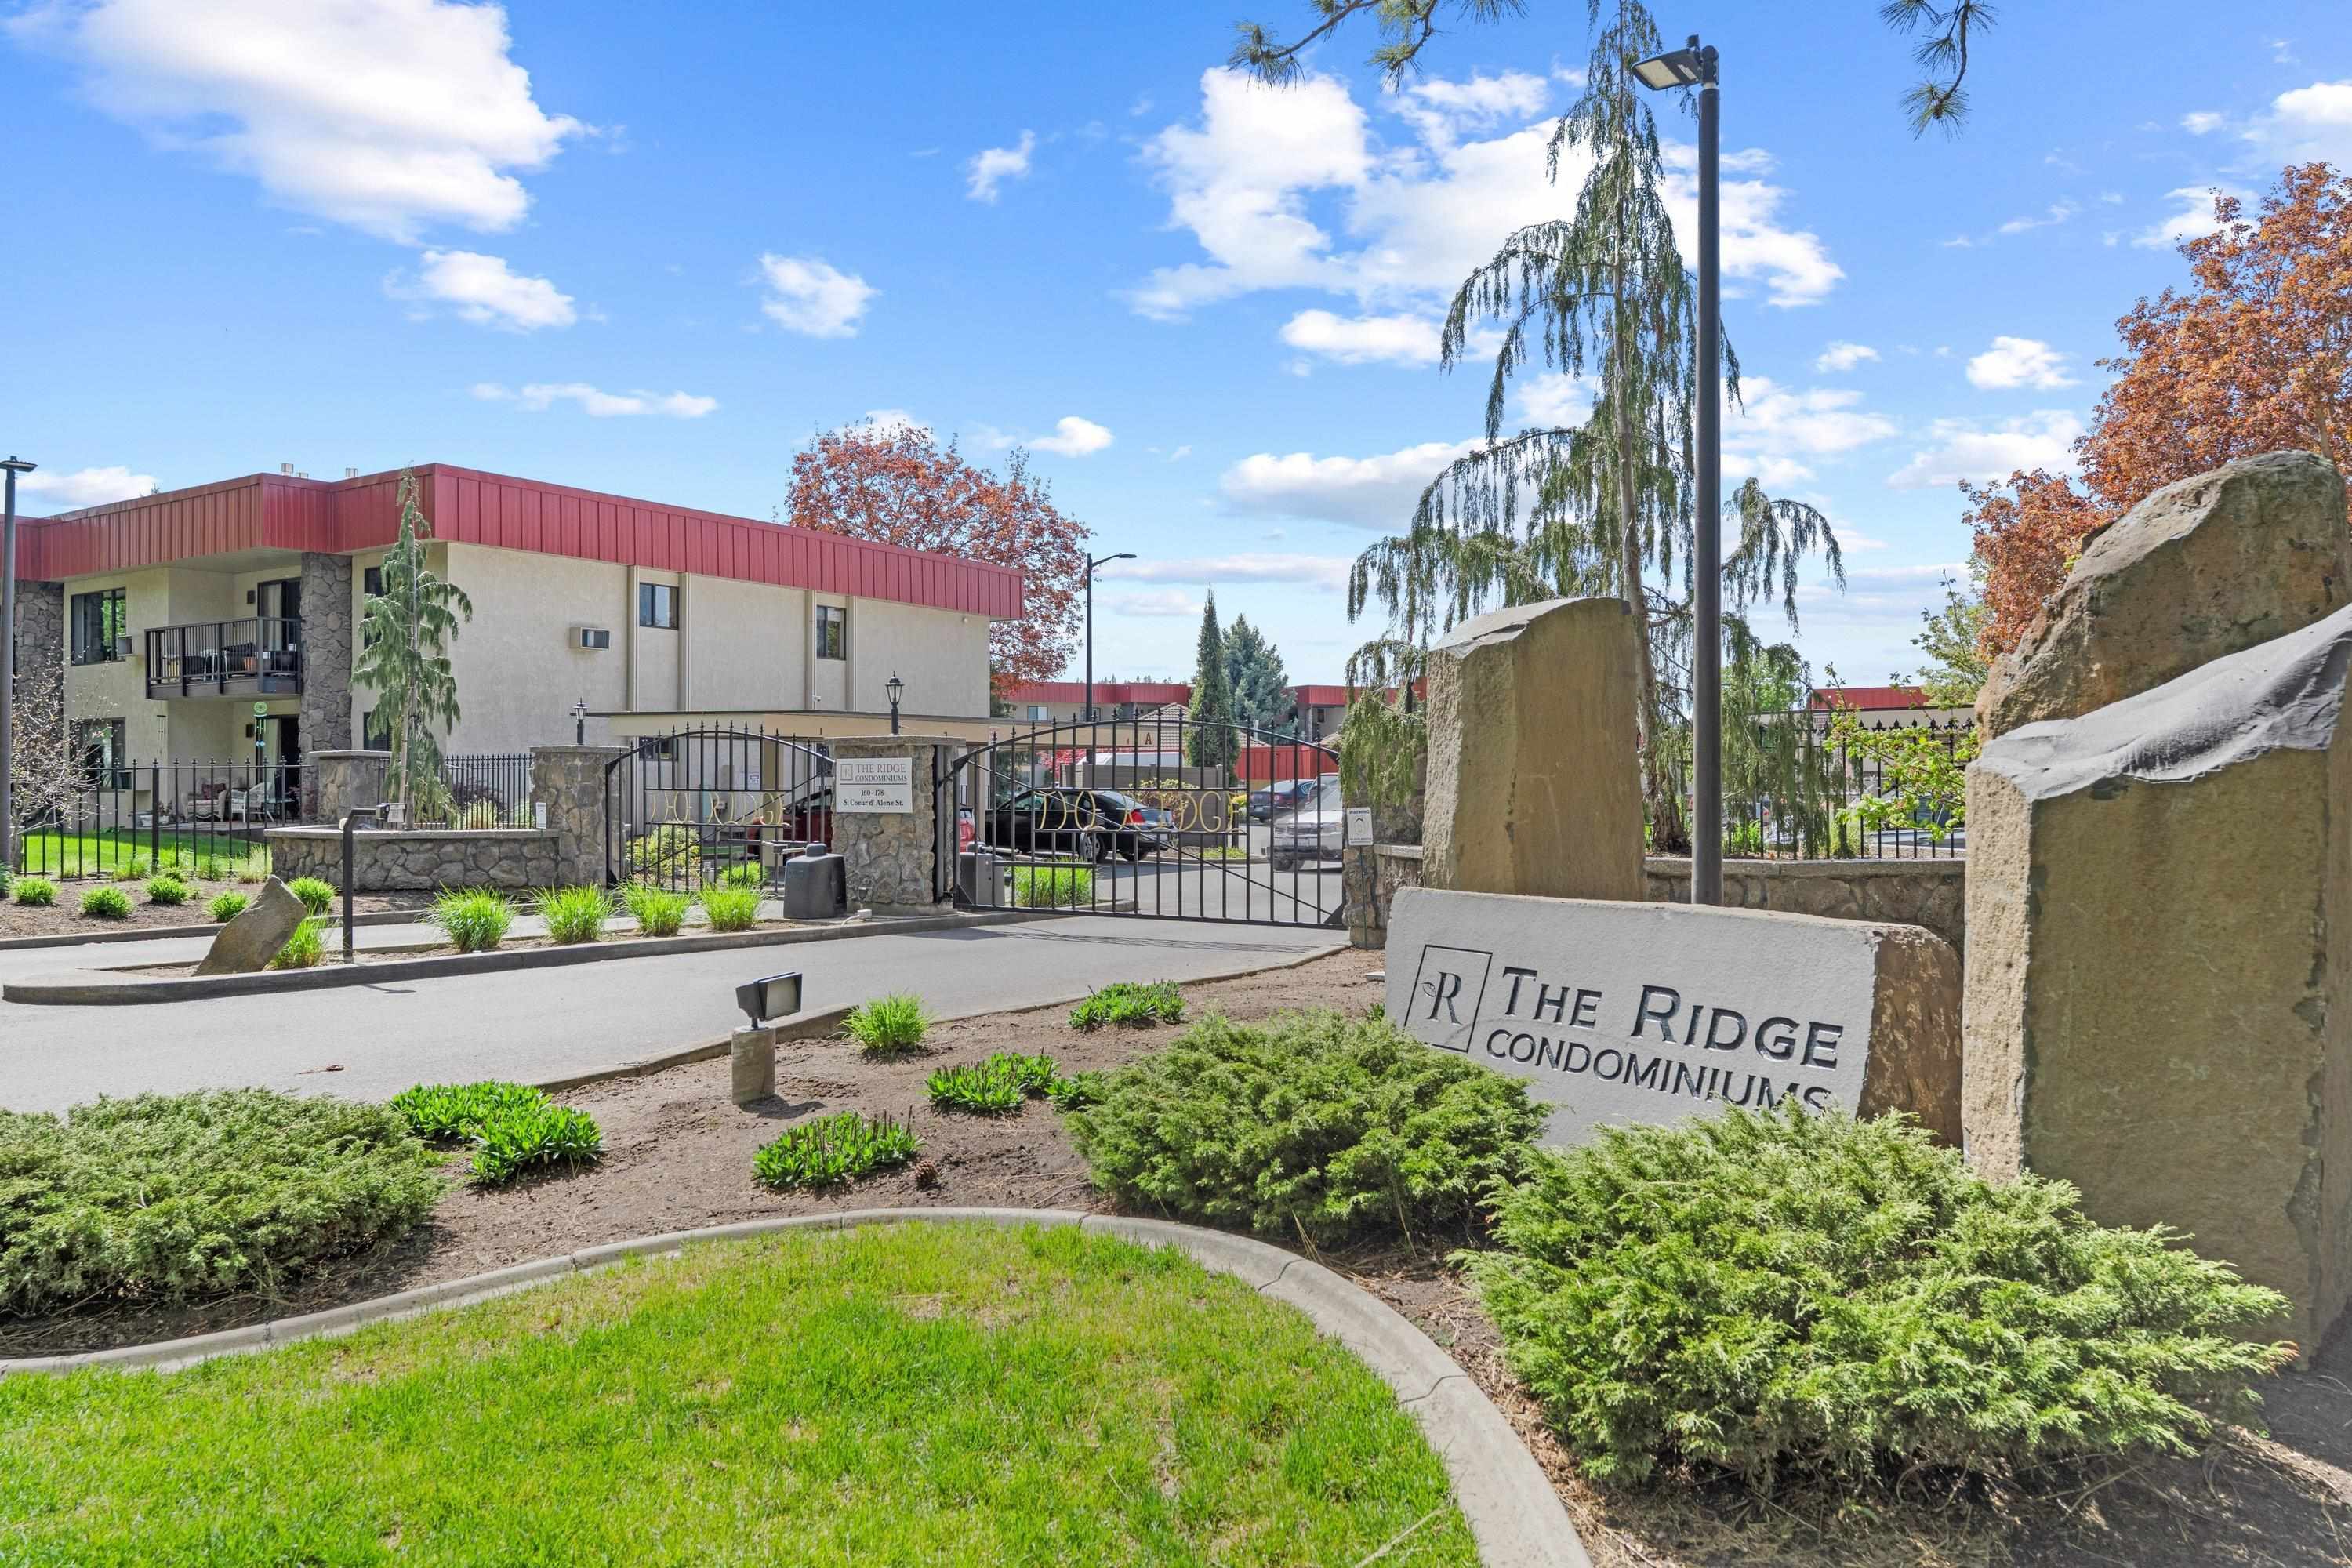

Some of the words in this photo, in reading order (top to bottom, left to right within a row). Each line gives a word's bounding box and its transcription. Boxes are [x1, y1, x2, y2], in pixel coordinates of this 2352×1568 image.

[1145, 732, 1152, 745] A
[857, 764, 875, 773] THE
[877, 764, 906, 773] RIDGE
[1502, 965, 1602, 1029] THE
[1631, 983, 1844, 1071] RIDGE
[1486, 1028, 1832, 1113] CONDOMINIUMS
